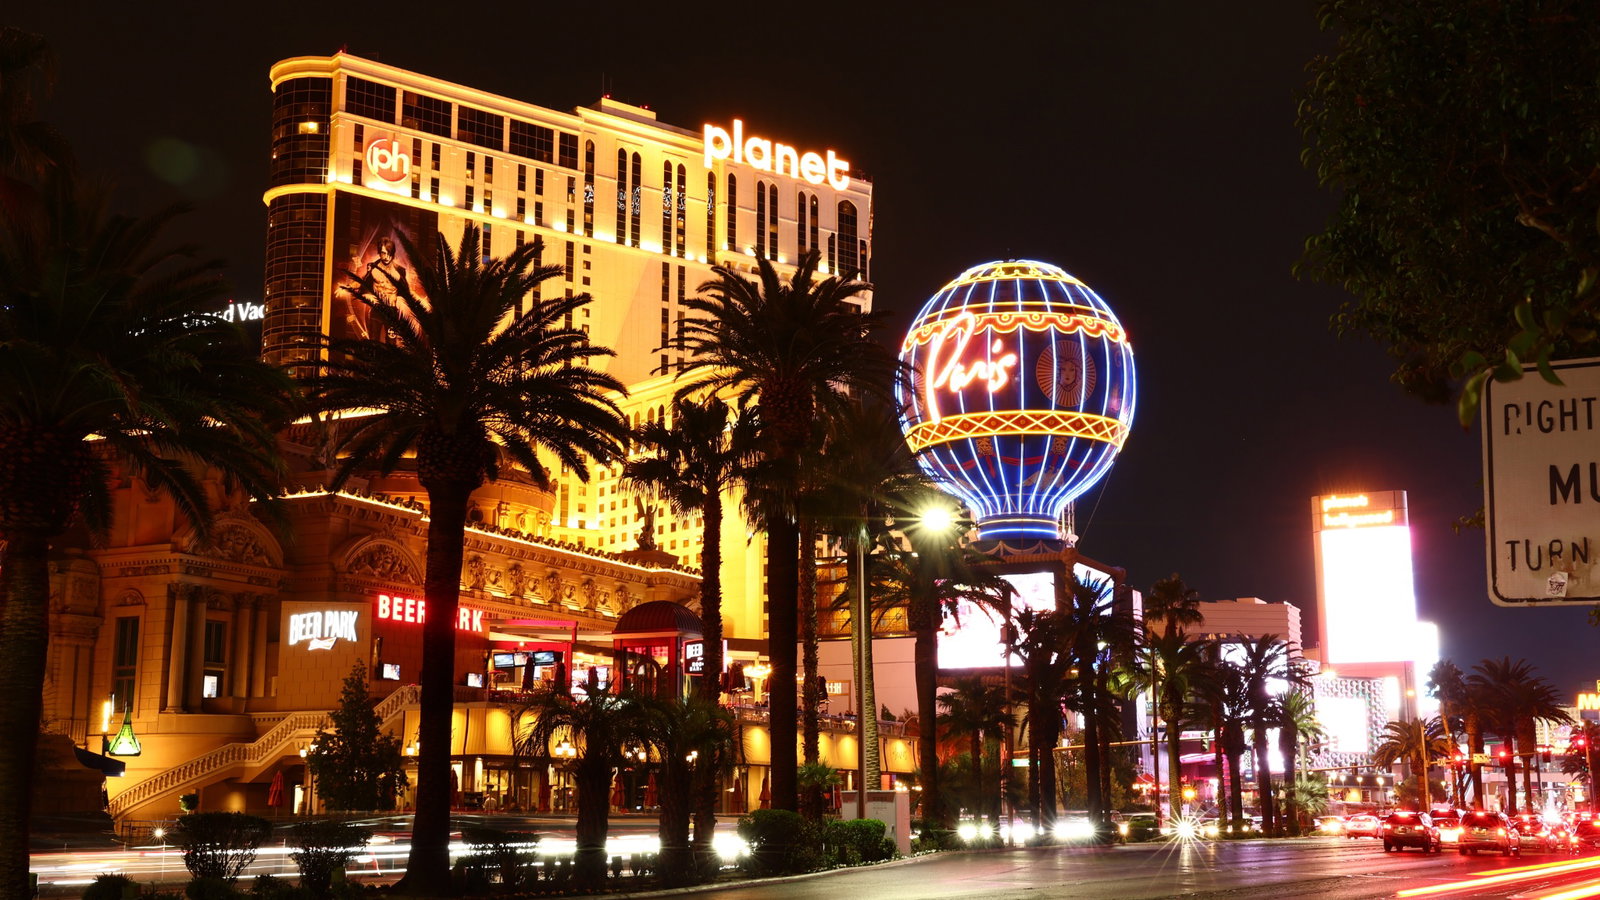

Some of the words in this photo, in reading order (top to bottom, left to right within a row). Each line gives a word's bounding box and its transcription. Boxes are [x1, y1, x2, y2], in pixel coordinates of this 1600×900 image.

[373, 141, 410, 174] ph
[704, 119, 850, 191] planet
[926, 311, 1017, 425] Paris
[1504, 397, 1597, 436] RIGHT
[1505, 537, 1589, 572] TURN
[289, 611, 322, 645] BEER
[324, 611, 359, 642] PARK
